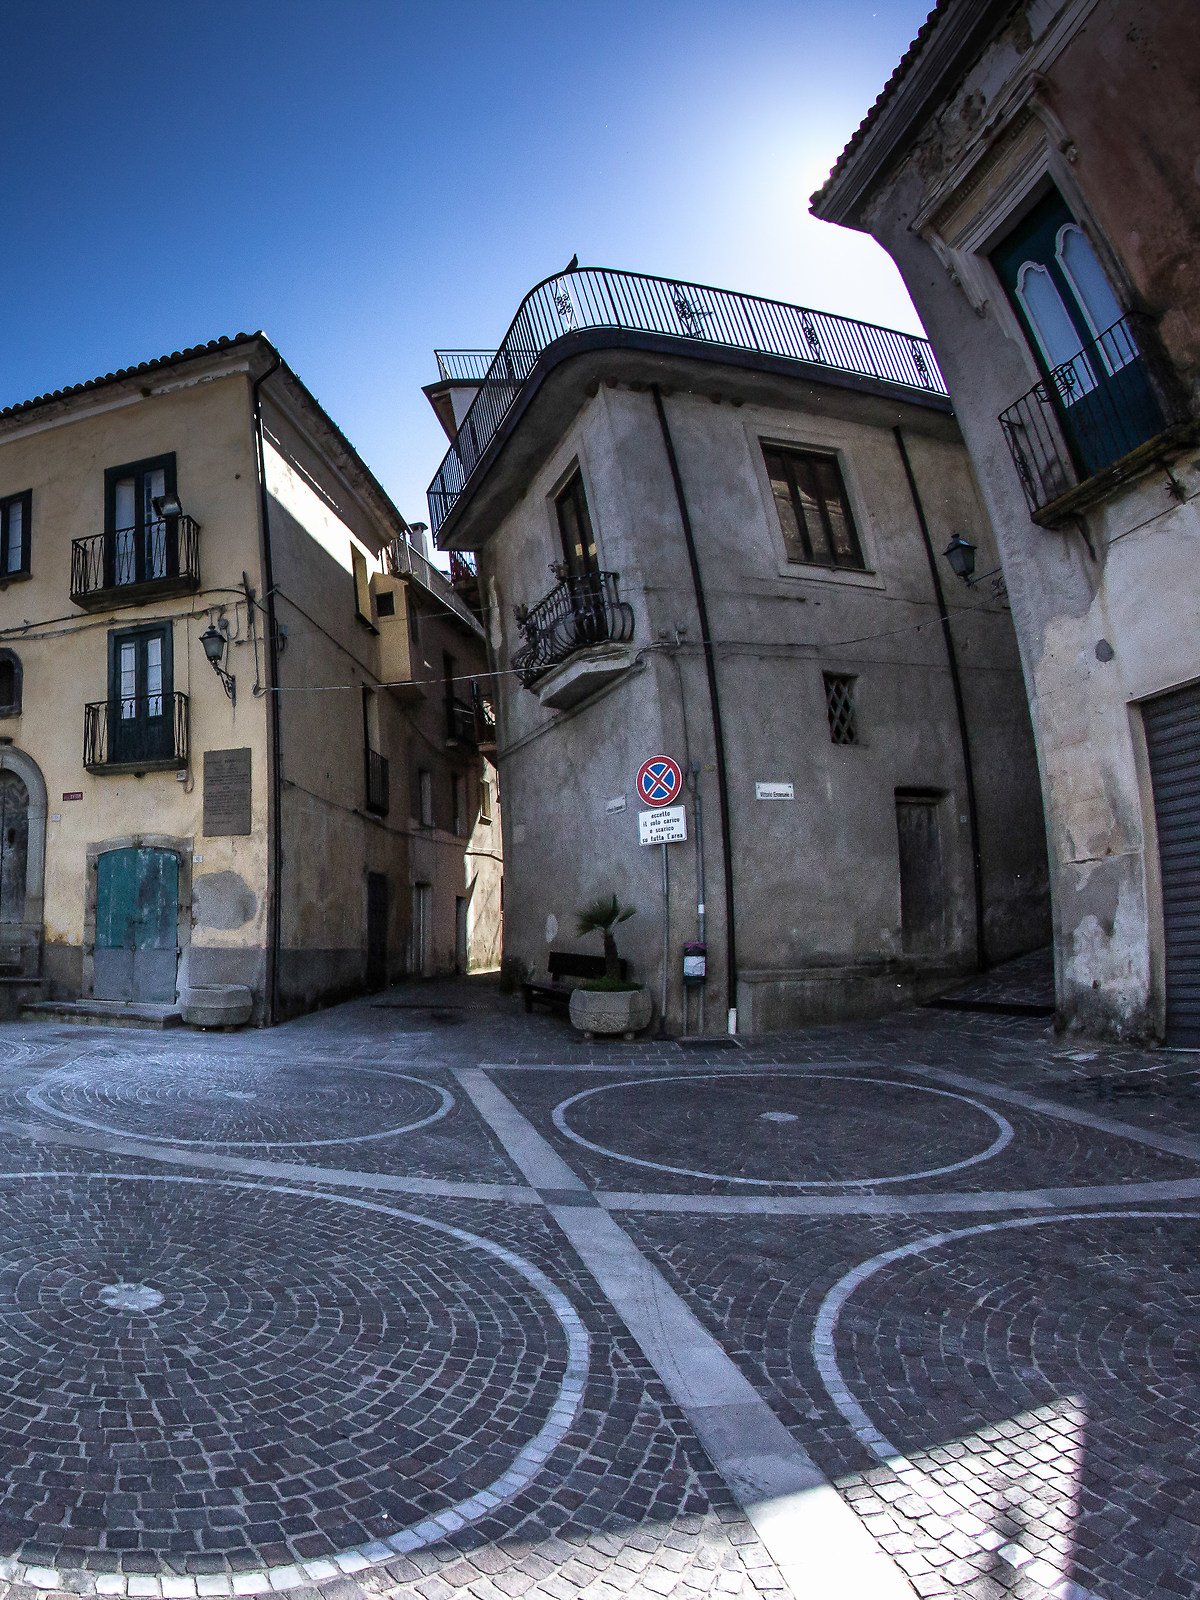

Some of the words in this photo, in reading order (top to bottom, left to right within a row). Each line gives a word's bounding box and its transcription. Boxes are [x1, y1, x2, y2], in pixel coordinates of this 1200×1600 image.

[651, 811, 671, 820] eccetto
[650, 819, 661, 827] solo
[663, 817, 680, 825] carico
[655, 826, 675, 834] scarico
[650, 834, 665, 842] tutta
[667, 832, 684, 840] l'area
